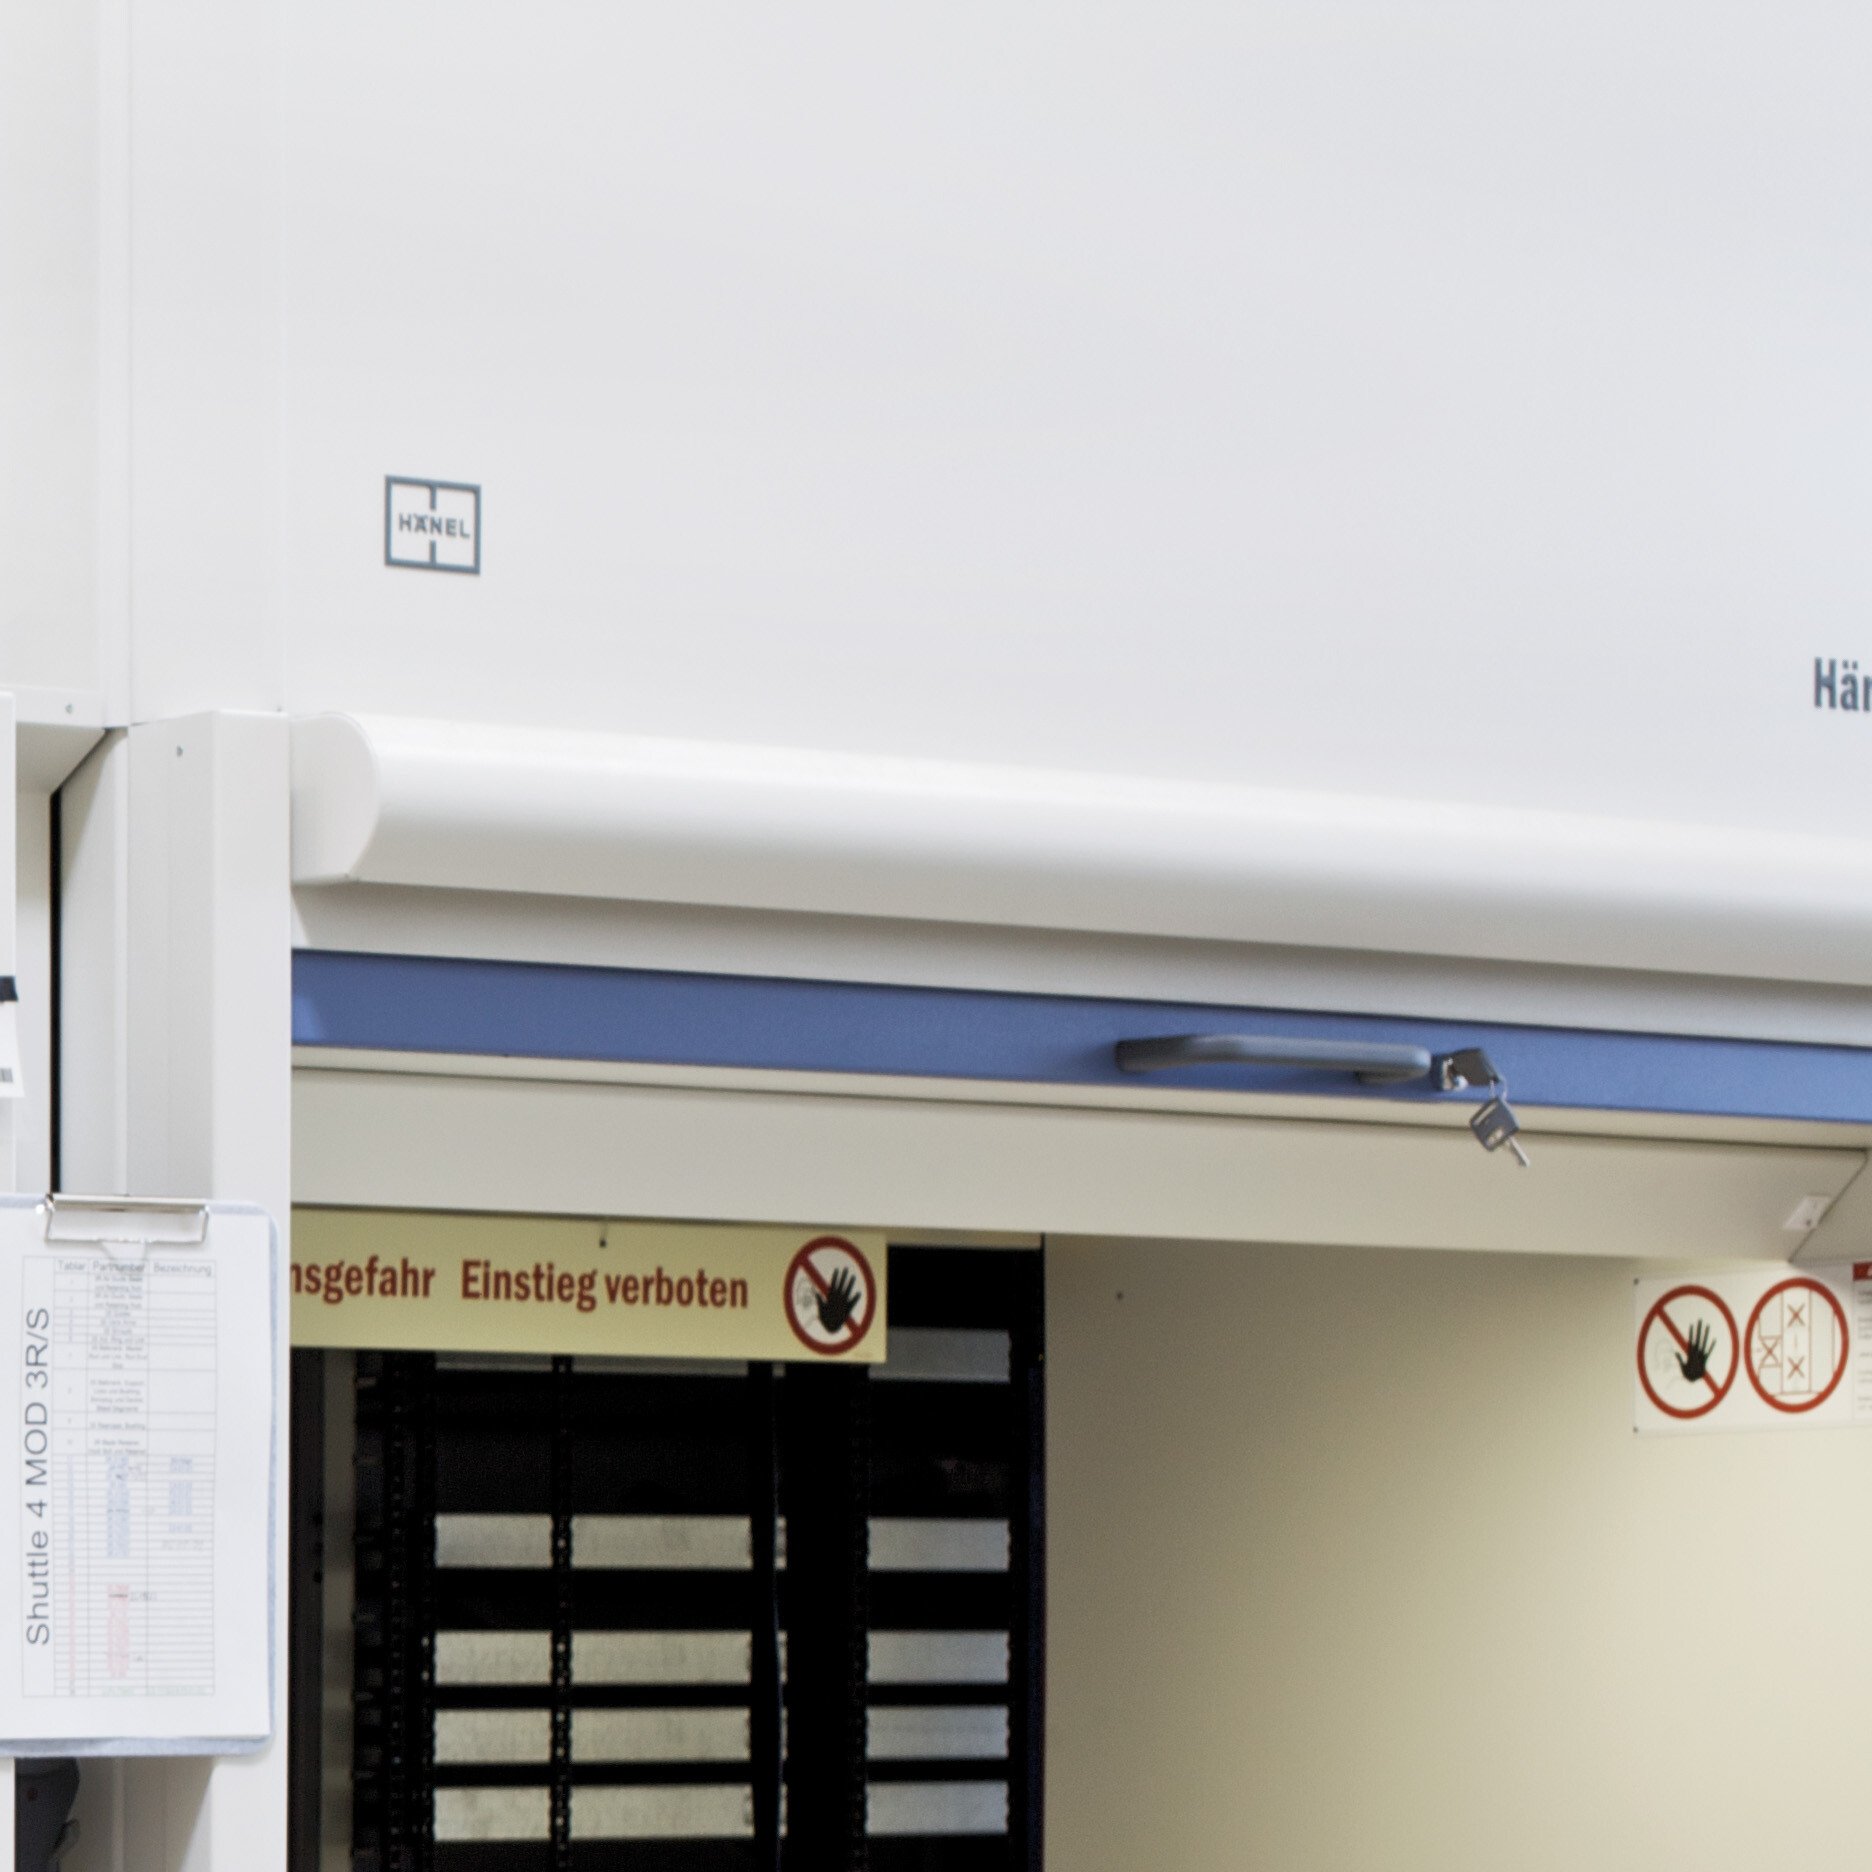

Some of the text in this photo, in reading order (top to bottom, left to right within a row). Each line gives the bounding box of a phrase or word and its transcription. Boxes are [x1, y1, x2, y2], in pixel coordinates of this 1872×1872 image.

[398, 511, 471, 540] HÄNEL
[461, 1258, 597, 1313] Einstieg
[605, 1267, 749, 1308] verboten
[23, 1306, 50, 1646] Shuttle 4 MOD 3R/S
